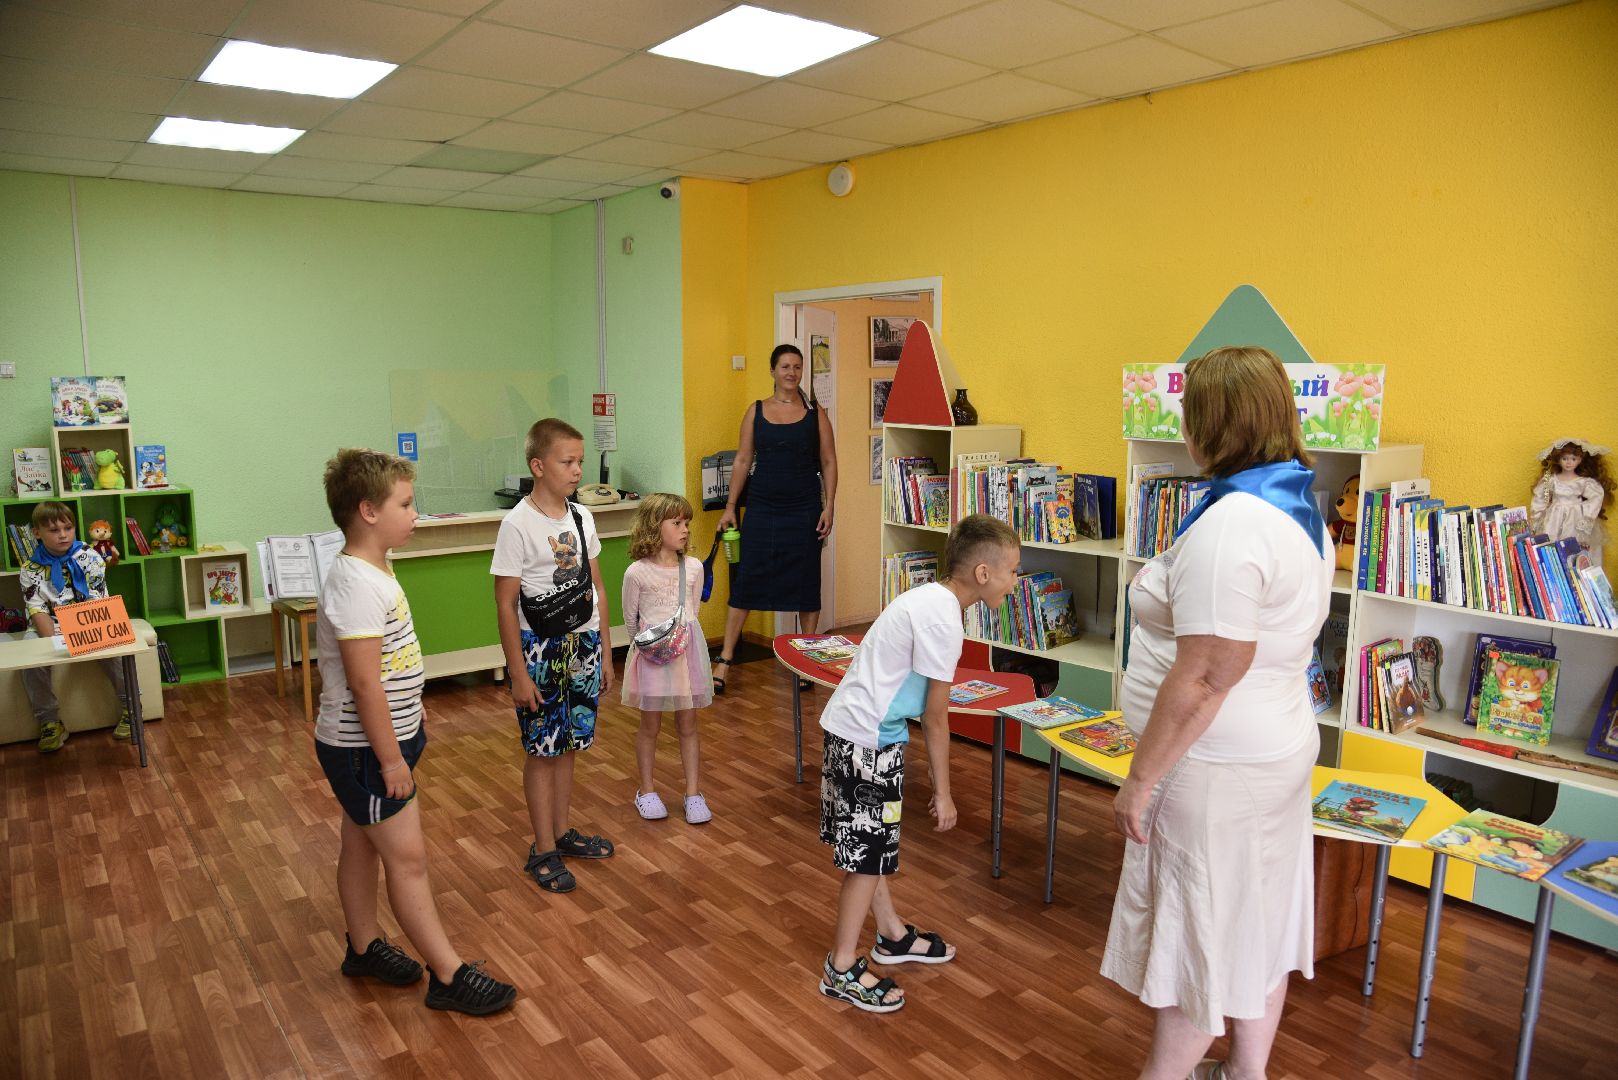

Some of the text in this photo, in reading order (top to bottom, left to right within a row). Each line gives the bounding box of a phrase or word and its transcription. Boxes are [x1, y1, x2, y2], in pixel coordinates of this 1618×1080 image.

[535, 577, 579, 602] adidas
[76, 606, 111, 626] СТИХИ
[68, 621, 130, 648] ПИШУ САМ
